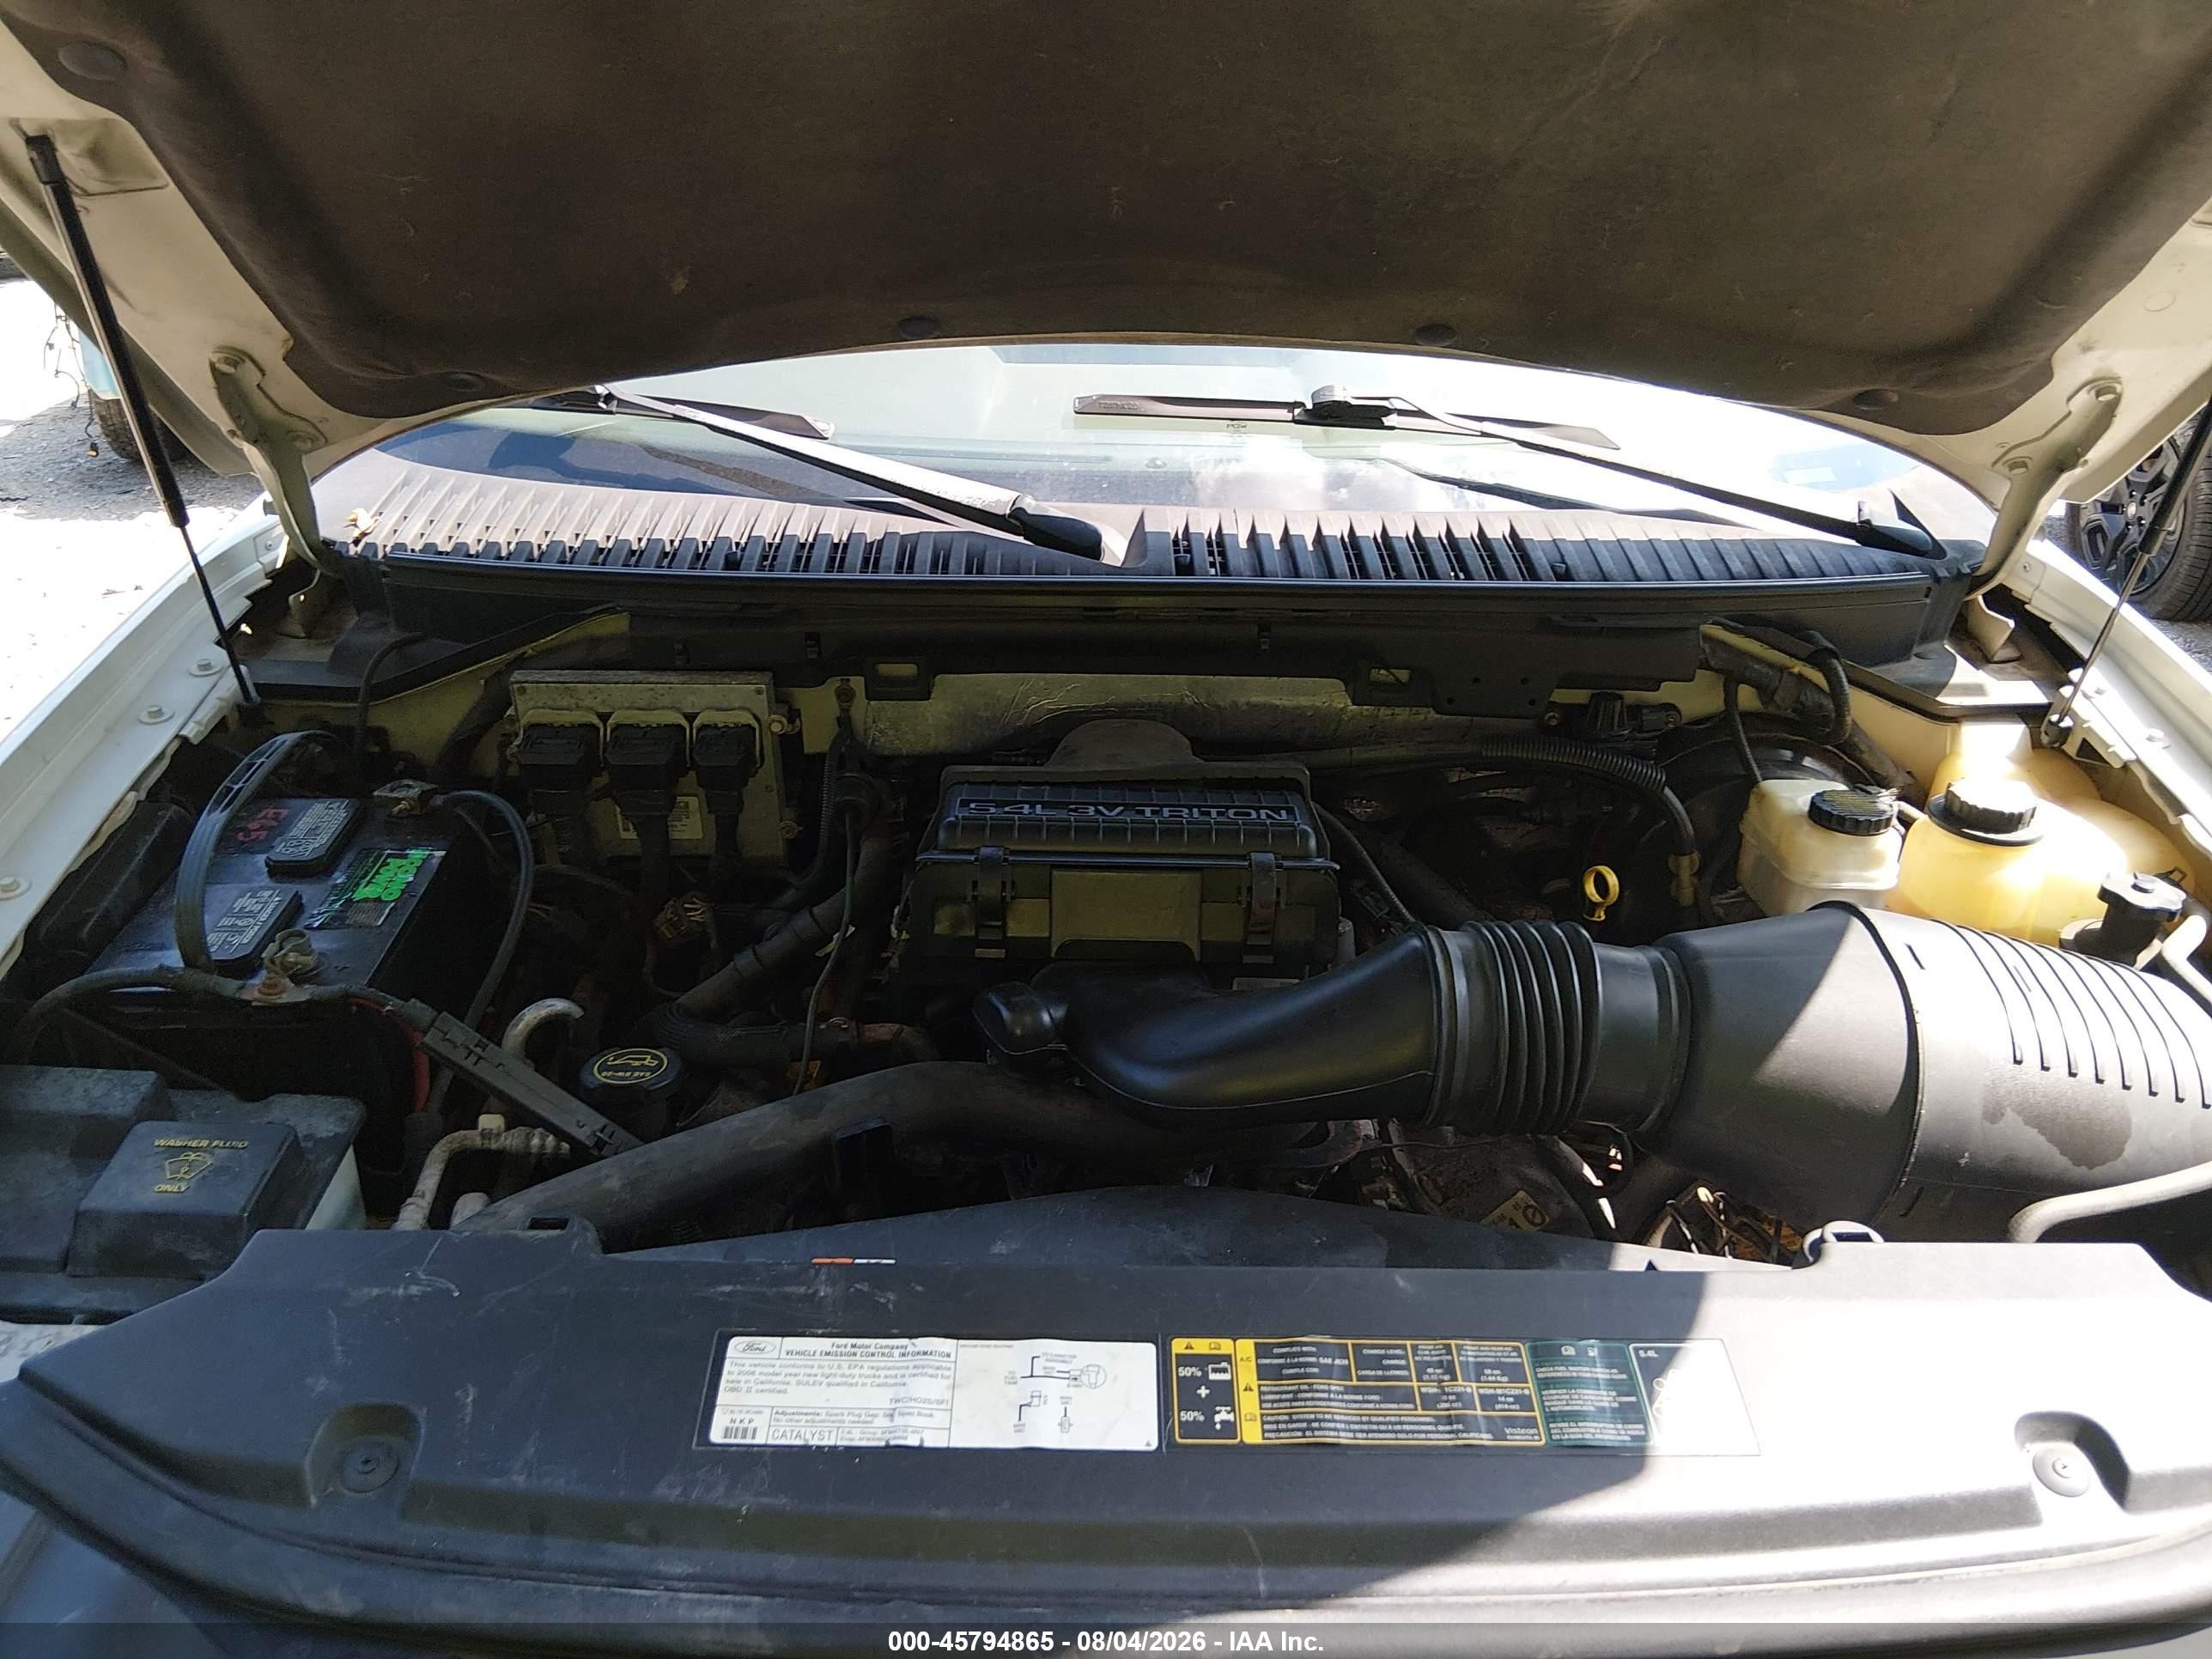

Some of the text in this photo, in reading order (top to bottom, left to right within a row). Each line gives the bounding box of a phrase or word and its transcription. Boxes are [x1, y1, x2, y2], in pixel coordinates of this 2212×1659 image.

[969, 802, 1288, 820] 5.4L 3V TRITON
[155, 1139, 248, 1148] WASHER FLUID
[154, 1183, 190, 1193] ONLY
[742, 1341, 768, 1352] Ford
[898, 1350, 951, 1358] INFORMATION
[867, 1364, 909, 1372] regulations
[912, 1363, 951, 1371] applicable
[1178, 1367, 1202, 1376] 50%
[1180, 1410, 1205, 1421] 50%
[772, 1428, 835, 1441] CATALYST
[1504, 1427, 1539, 1436] Visteon
